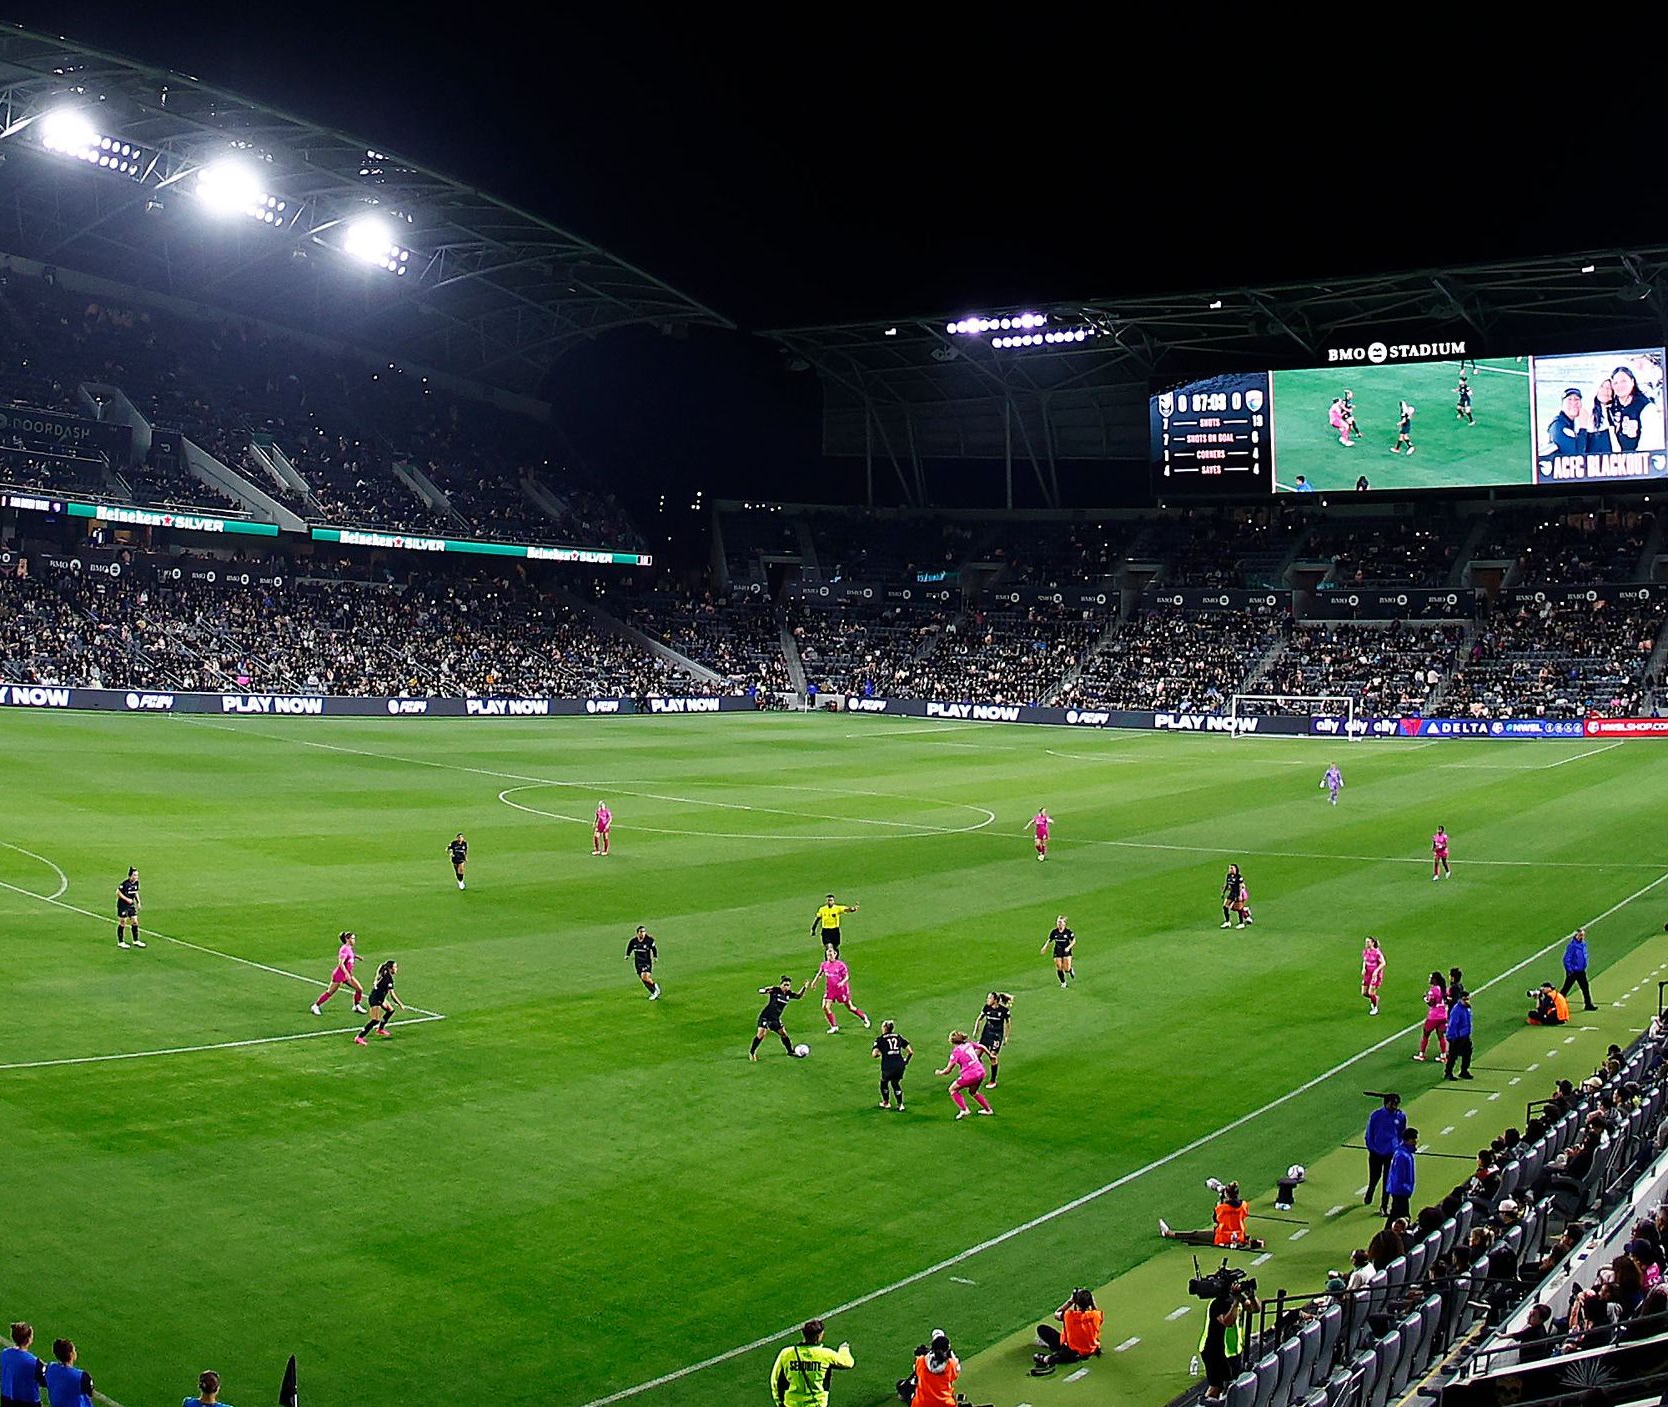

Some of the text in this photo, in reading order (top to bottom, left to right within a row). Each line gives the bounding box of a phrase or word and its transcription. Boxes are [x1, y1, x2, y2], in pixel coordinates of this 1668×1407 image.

[1328, 341, 1466, 361] BMO STADIUM
[1232, 392, 1241, 410] 0
[12, 419, 91, 439] DOORDASH
[1199, 418, 1220, 427] SHOTS
[1553, 452, 1650, 479] ACFC BLACKOUT
[96, 505, 224, 532] Heineken SILVER
[339, 530, 444, 551] Heineken SILVER
[527, 546, 569, 561] Heineken
[12, 687, 69, 707] NOW
[139, 694, 174, 709] FC24
[222, 696, 323, 714] PLAY NOW
[651, 698, 719, 712] PLAY NOW
[466, 699, 548, 714] PLAY NOW
[926, 702, 1019, 721] PLAY NOW
[1154, 714, 1258, 732] PLAY NOW
[1316, 718, 1339, 734] ally
[1373, 719, 1398, 734] ally
[1442, 723, 1488, 733] DELTA
[887, 1037, 899, 1050] 12
